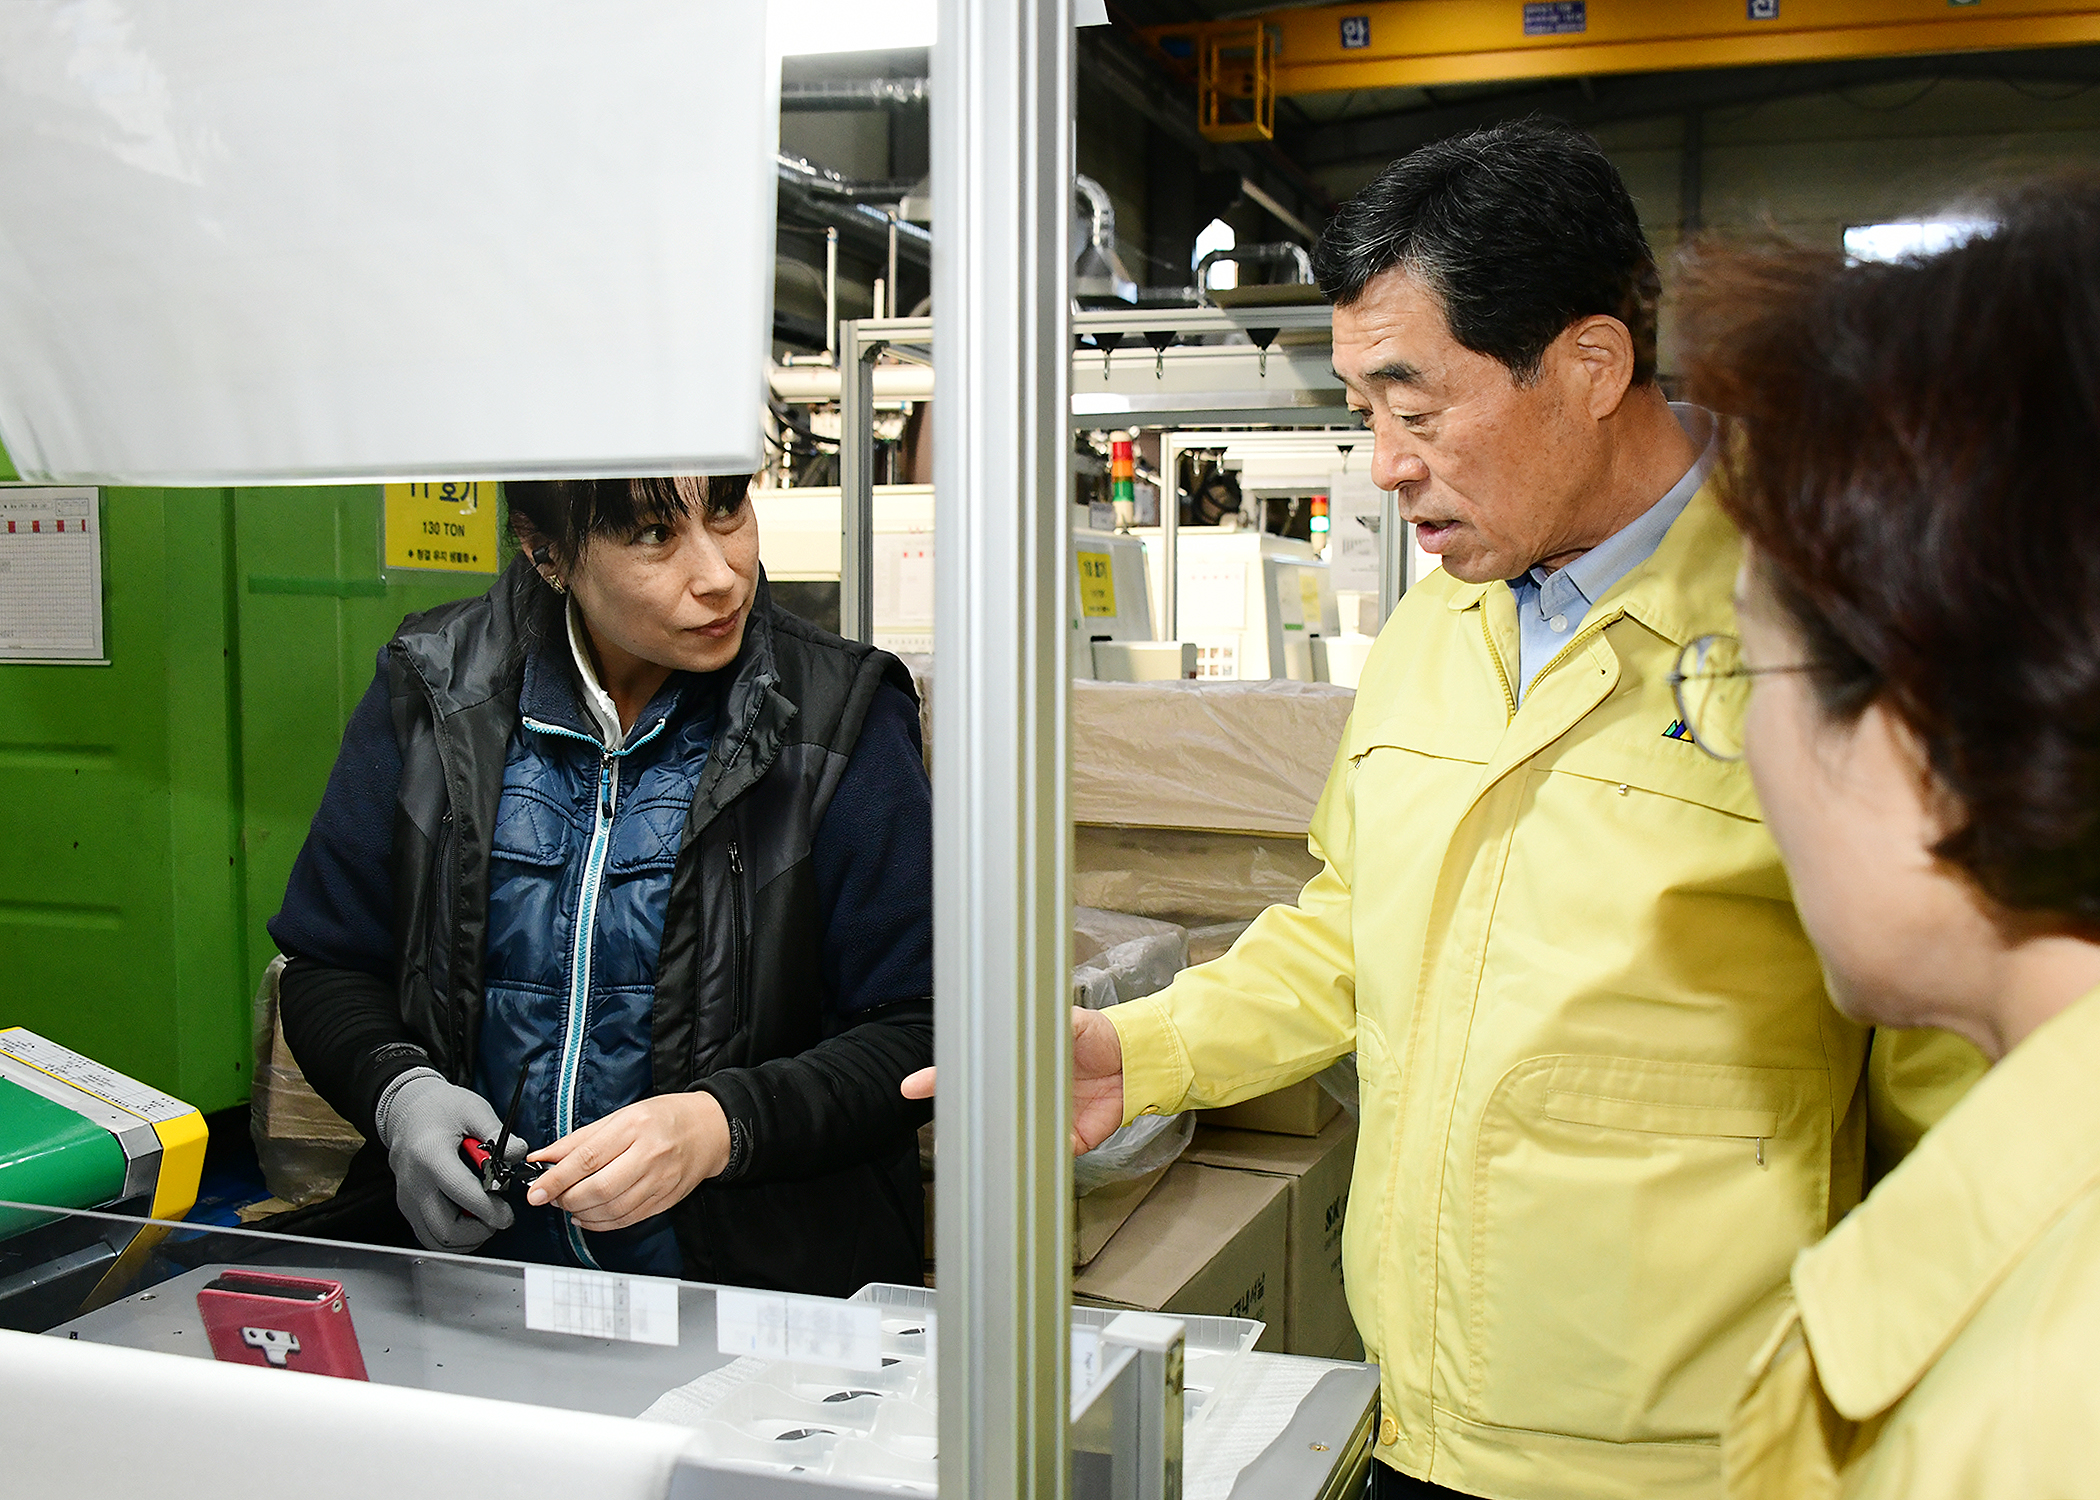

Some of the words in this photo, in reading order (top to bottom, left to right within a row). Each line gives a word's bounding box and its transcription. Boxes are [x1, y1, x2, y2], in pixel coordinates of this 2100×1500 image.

[1343, 18, 1367, 47] 안
[423, 521, 440, 535] 130
[444, 523, 465, 536] TON
